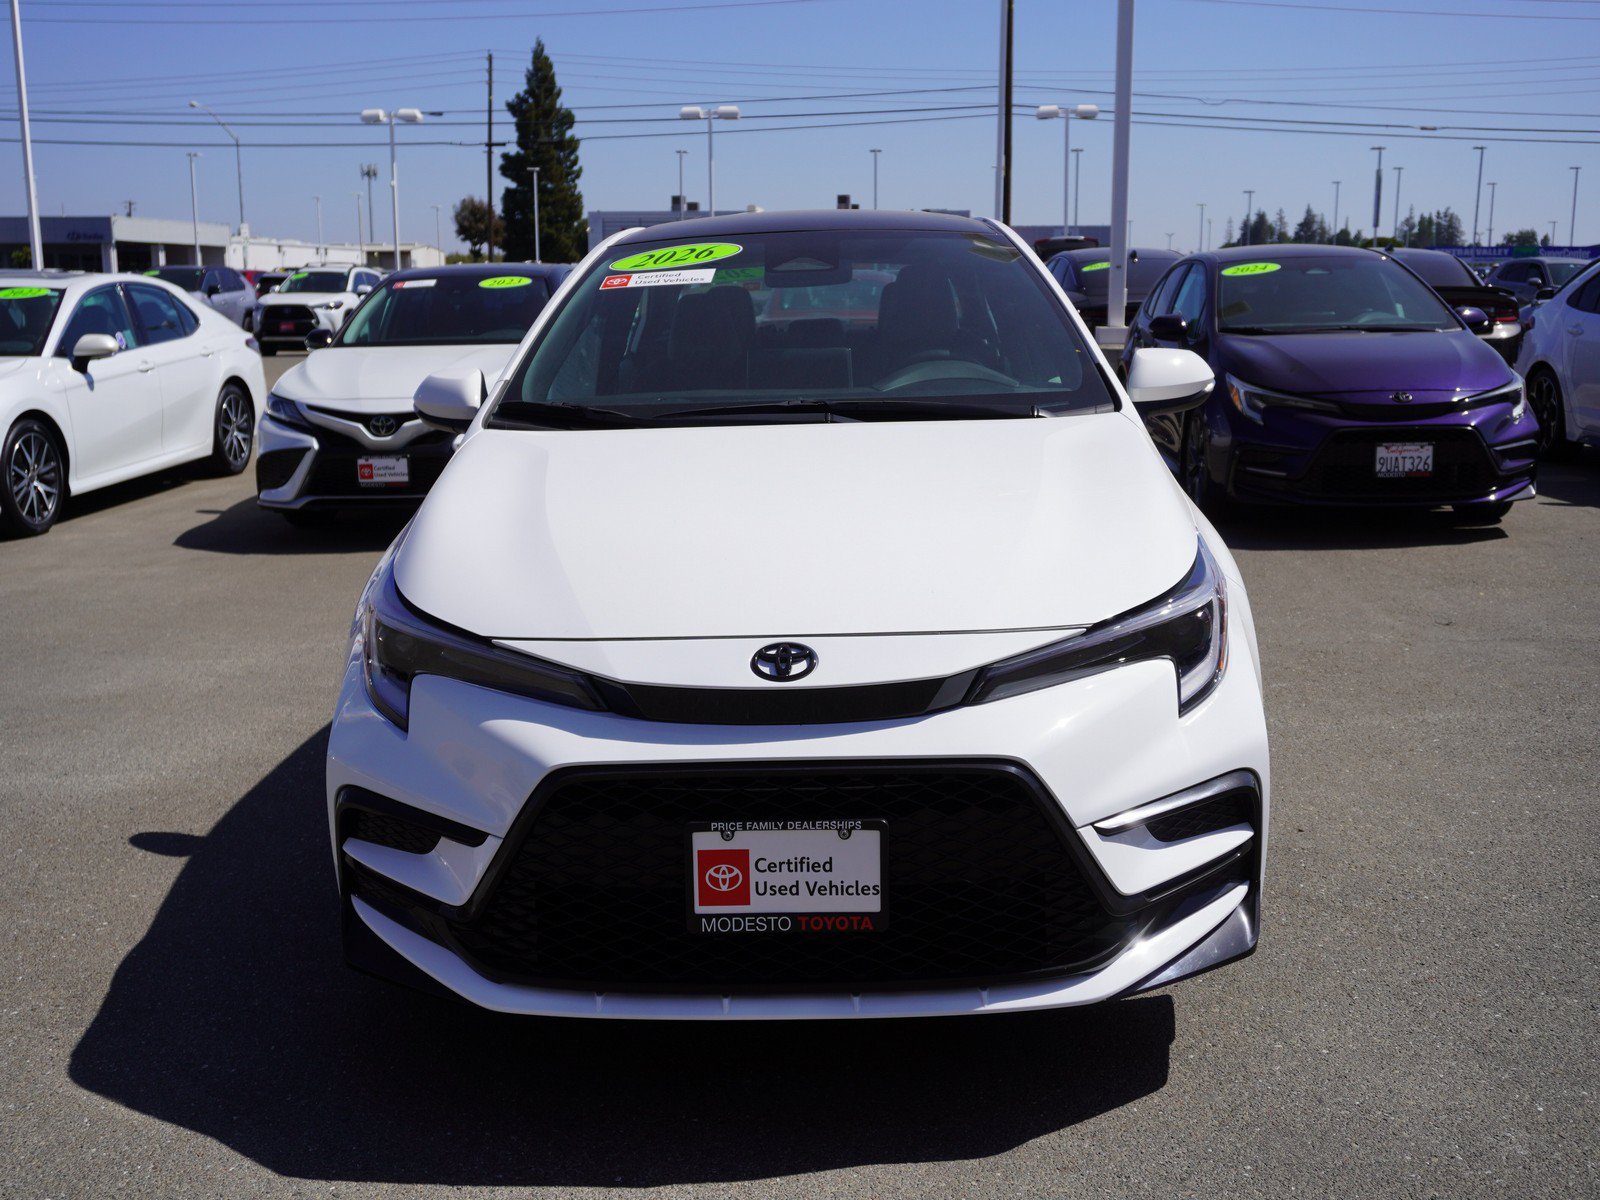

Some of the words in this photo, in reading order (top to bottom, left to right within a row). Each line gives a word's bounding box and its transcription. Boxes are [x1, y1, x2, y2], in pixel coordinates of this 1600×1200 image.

[630, 245, 719, 268] 2026
[1476, 248, 1509, 256] VALLEY
[1378, 455, 1430, 472] 9UAT326
[710, 822, 743, 831] PRICE
[746, 821, 784, 830] FAMILY
[787, 820, 862, 830] DEALERSHIPS
[754, 856, 833, 873] Certified
[755, 880, 799, 896] Used
[805, 879, 880, 896] Vehicles
[701, 917, 792, 932] MODESTO
[797, 916, 873, 931] TOYOTA
